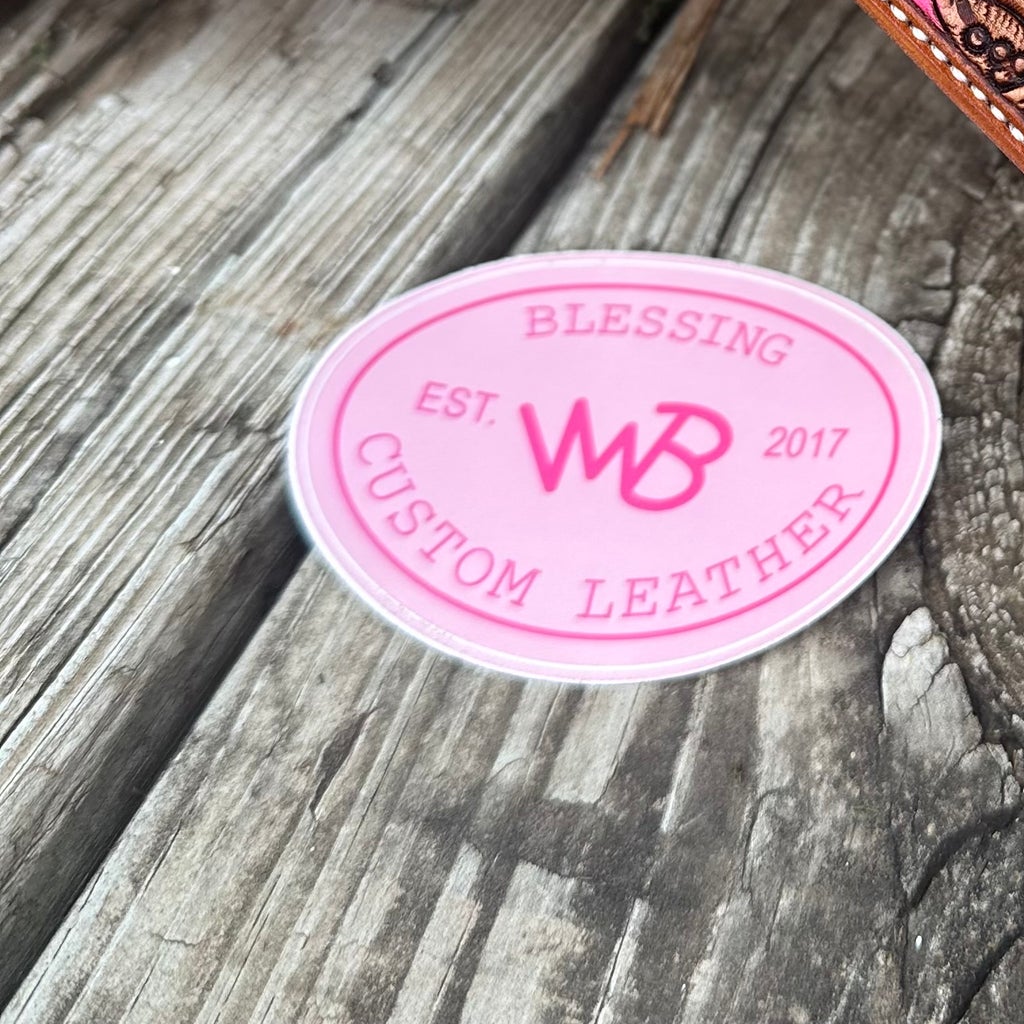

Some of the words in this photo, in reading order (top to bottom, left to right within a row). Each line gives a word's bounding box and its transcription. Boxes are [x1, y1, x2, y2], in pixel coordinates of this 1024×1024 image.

[524, 303, 795, 367] BLESSING
[415, 380, 499, 426] EST.
[763, 426, 850, 459] 2017
[357, 432, 542, 608] CUSTOM
[577, 481, 865, 619] LEATHER
